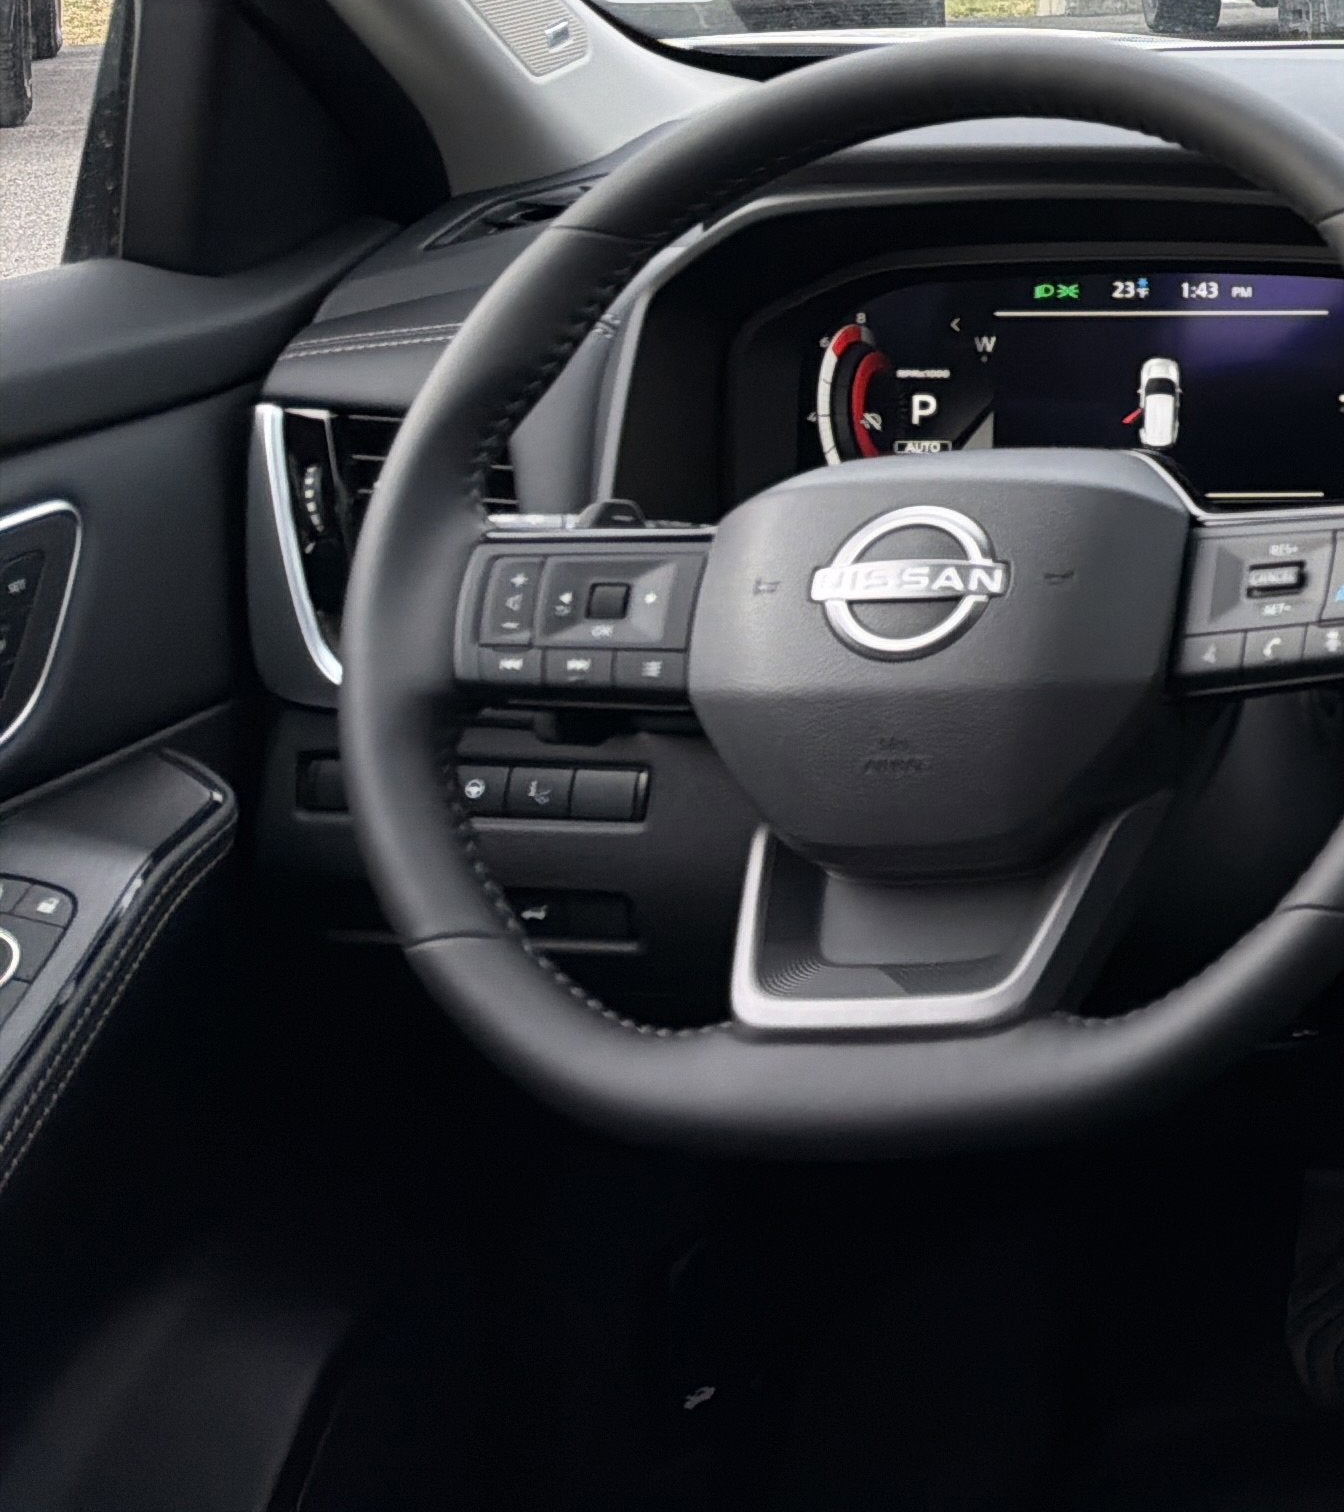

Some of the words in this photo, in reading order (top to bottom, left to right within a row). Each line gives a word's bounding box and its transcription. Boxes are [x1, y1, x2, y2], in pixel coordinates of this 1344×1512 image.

[1181, 281, 1219, 299] 1:43
[1231, 286, 1253, 298] PM
[855, 313, 866, 324] 8
[974, 336, 996, 352] W
[911, 393, 937, 425] P
[904, 441, 941, 453] AUTO
